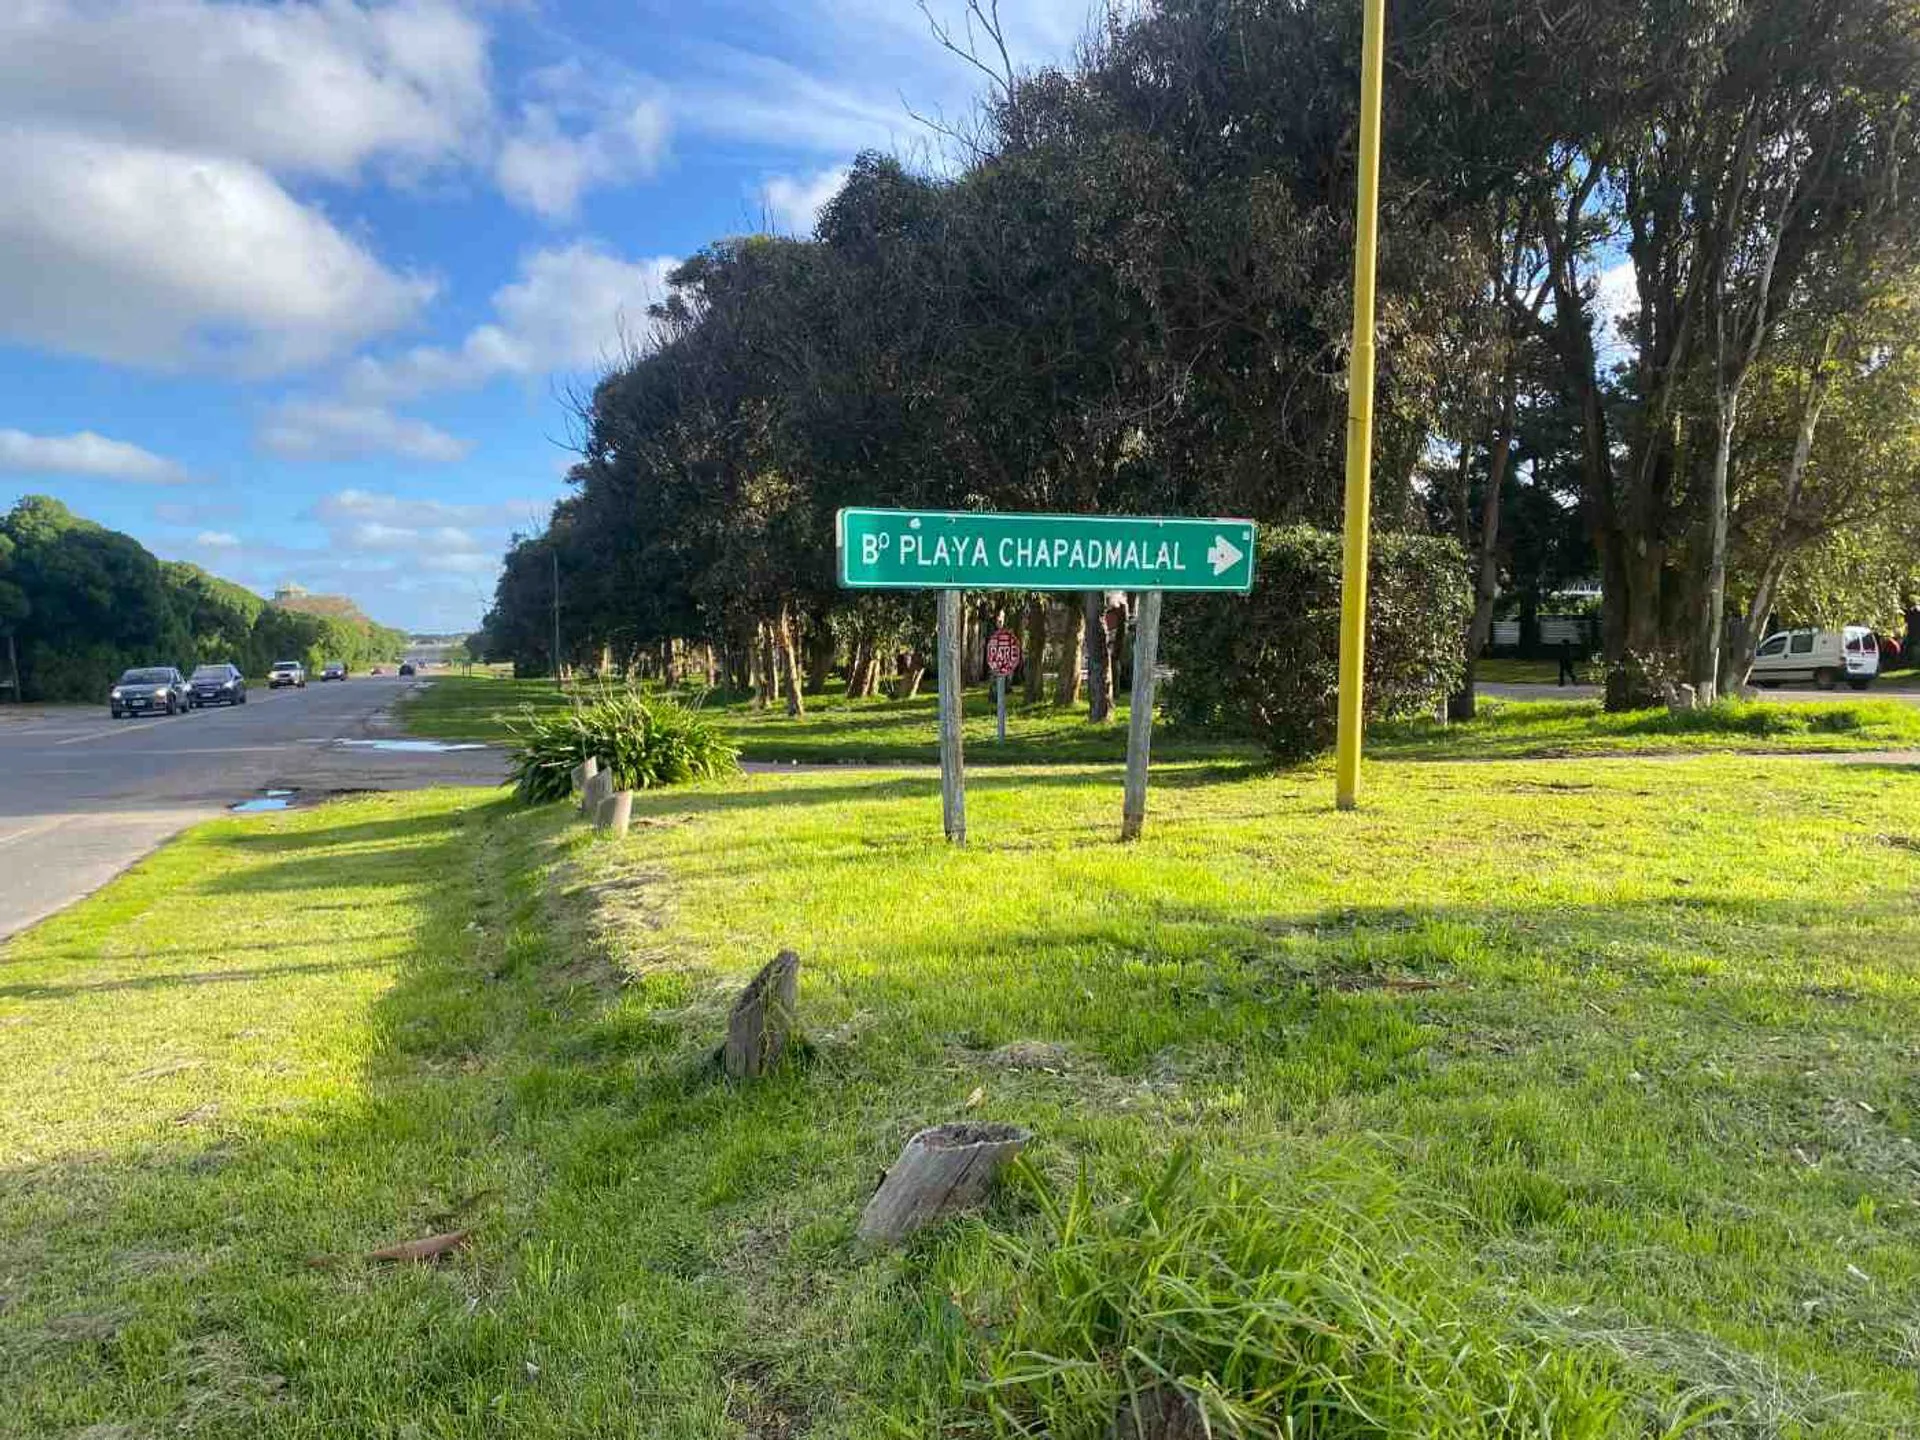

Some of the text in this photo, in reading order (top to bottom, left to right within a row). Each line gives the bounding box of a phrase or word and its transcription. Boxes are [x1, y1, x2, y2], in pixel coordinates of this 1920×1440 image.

[900, 535, 988, 566] PLAYA
[999, 538, 1186, 571] CHAPADMALAL
[990, 646, 1018, 661] PARE
